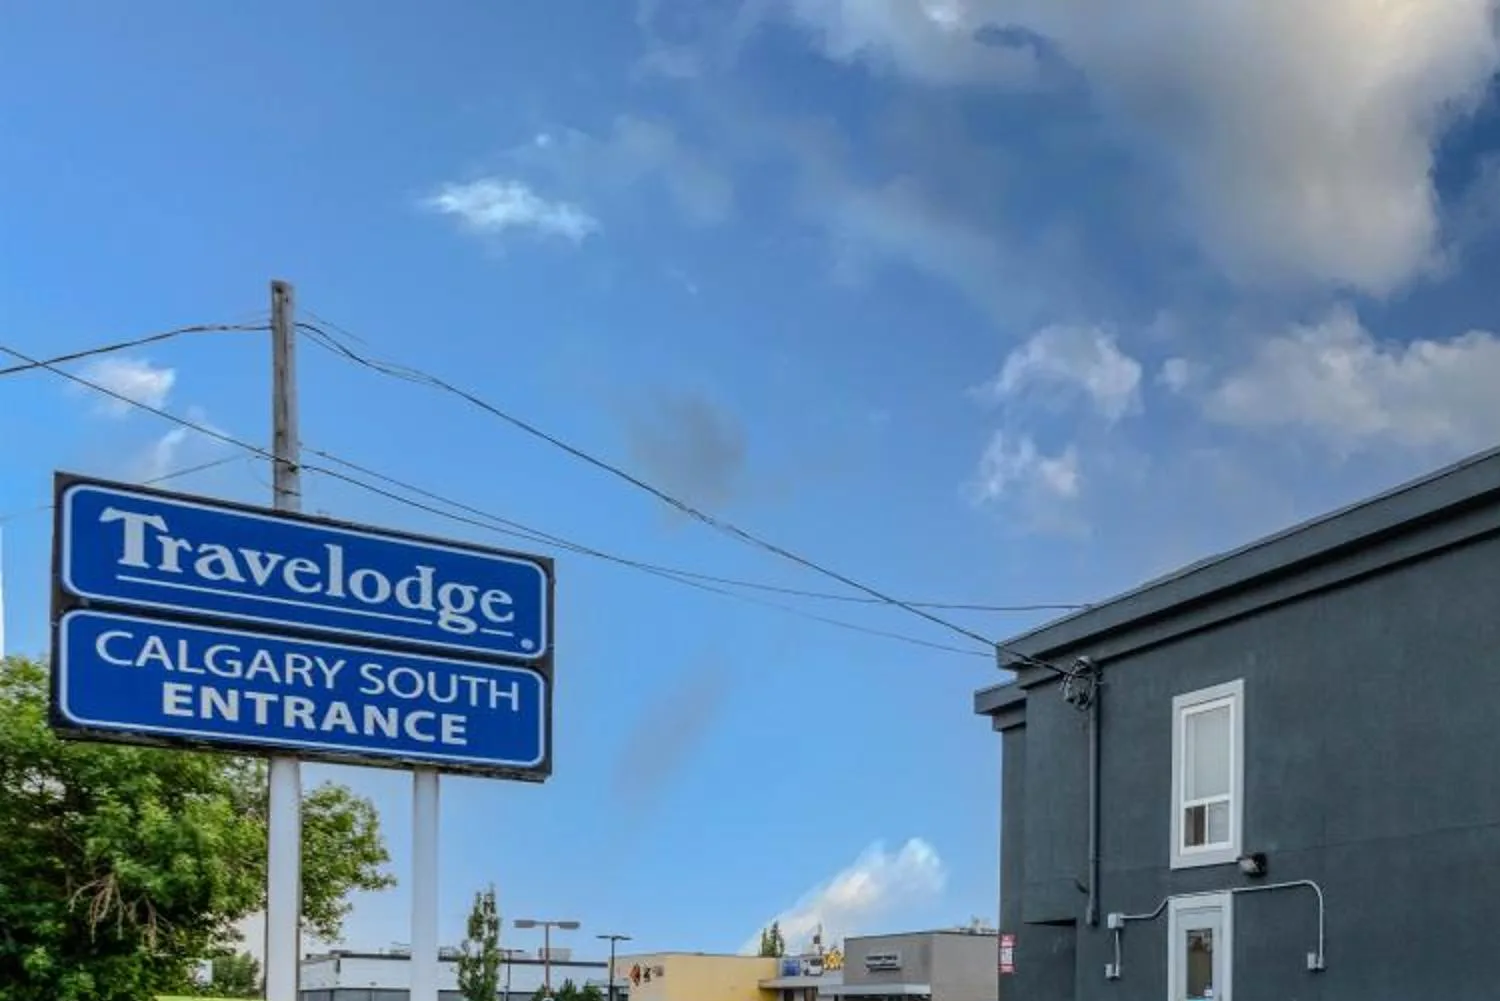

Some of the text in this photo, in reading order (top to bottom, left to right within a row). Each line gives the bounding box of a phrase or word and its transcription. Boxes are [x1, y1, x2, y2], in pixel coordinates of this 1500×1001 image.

[99, 507, 516, 635] Travelodge
[95, 630, 520, 712] CALGARY SOUTH
[163, 682, 468, 746] ENTRANCE
